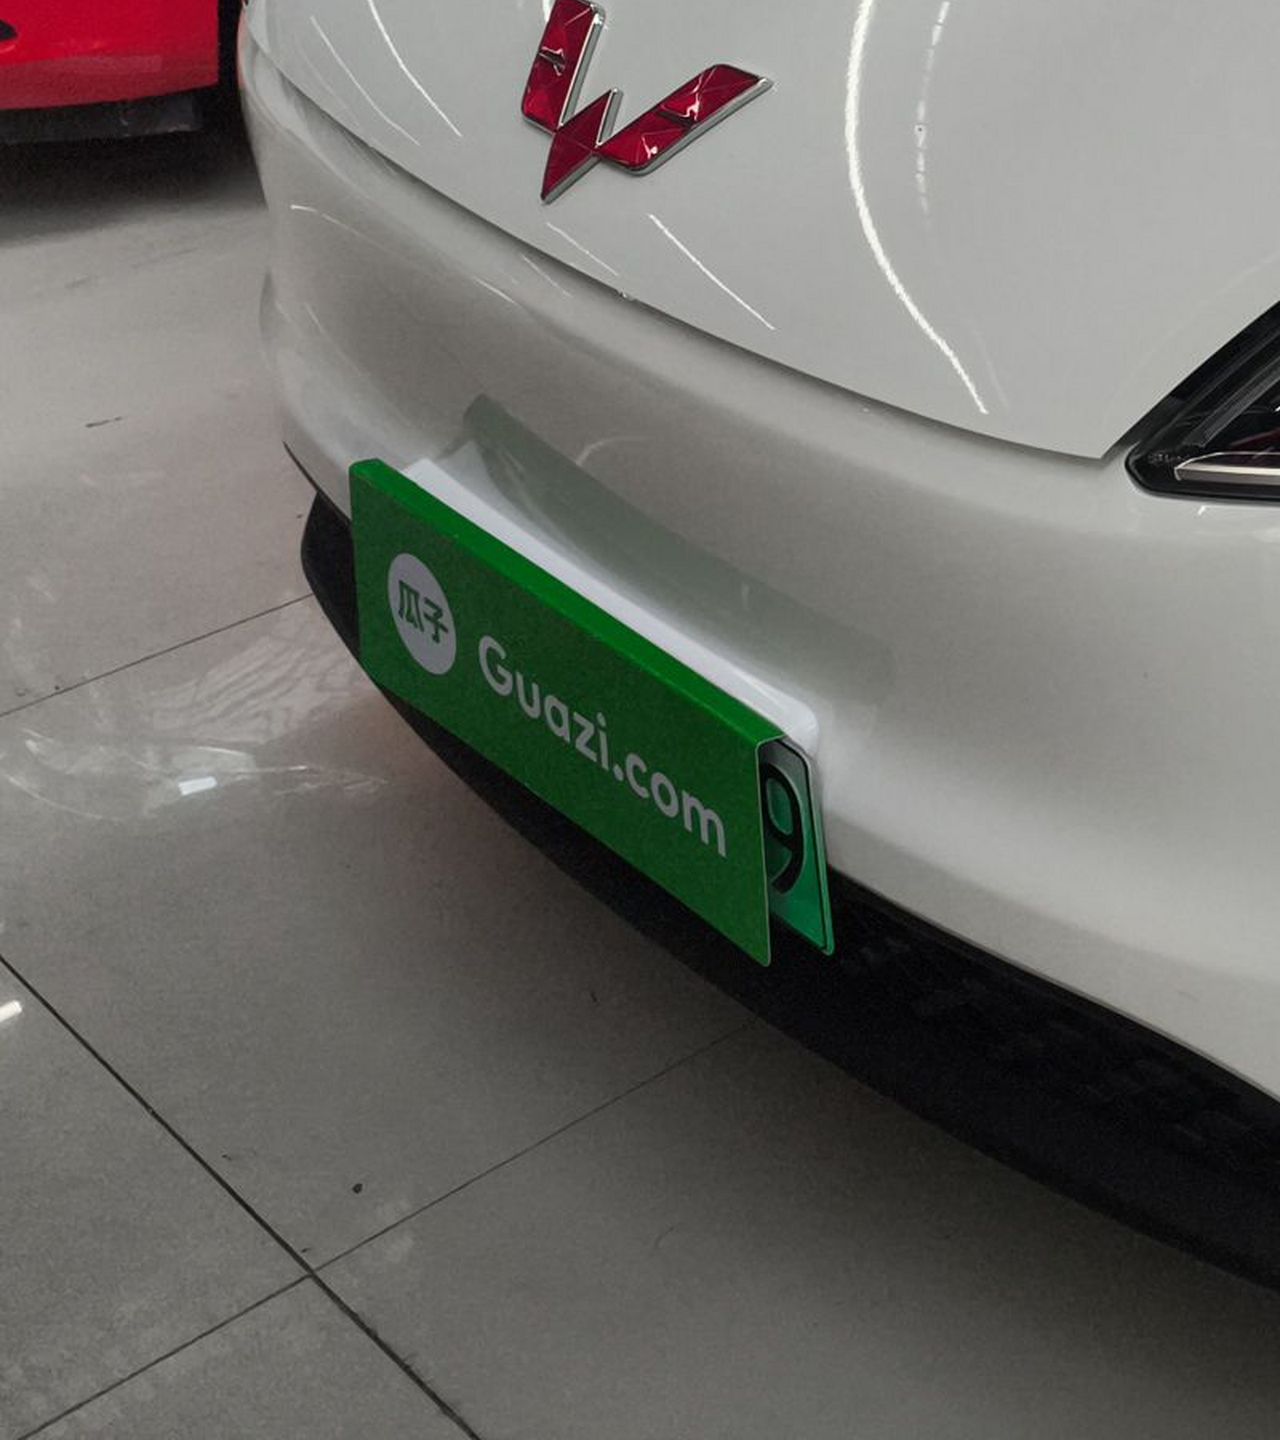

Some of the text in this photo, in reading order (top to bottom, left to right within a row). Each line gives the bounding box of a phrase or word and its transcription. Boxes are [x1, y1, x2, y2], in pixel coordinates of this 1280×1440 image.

[398, 579, 449, 645] 瓜子
[478, 635, 728, 858] Guazi.com
[761, 760, 805, 895] 9
